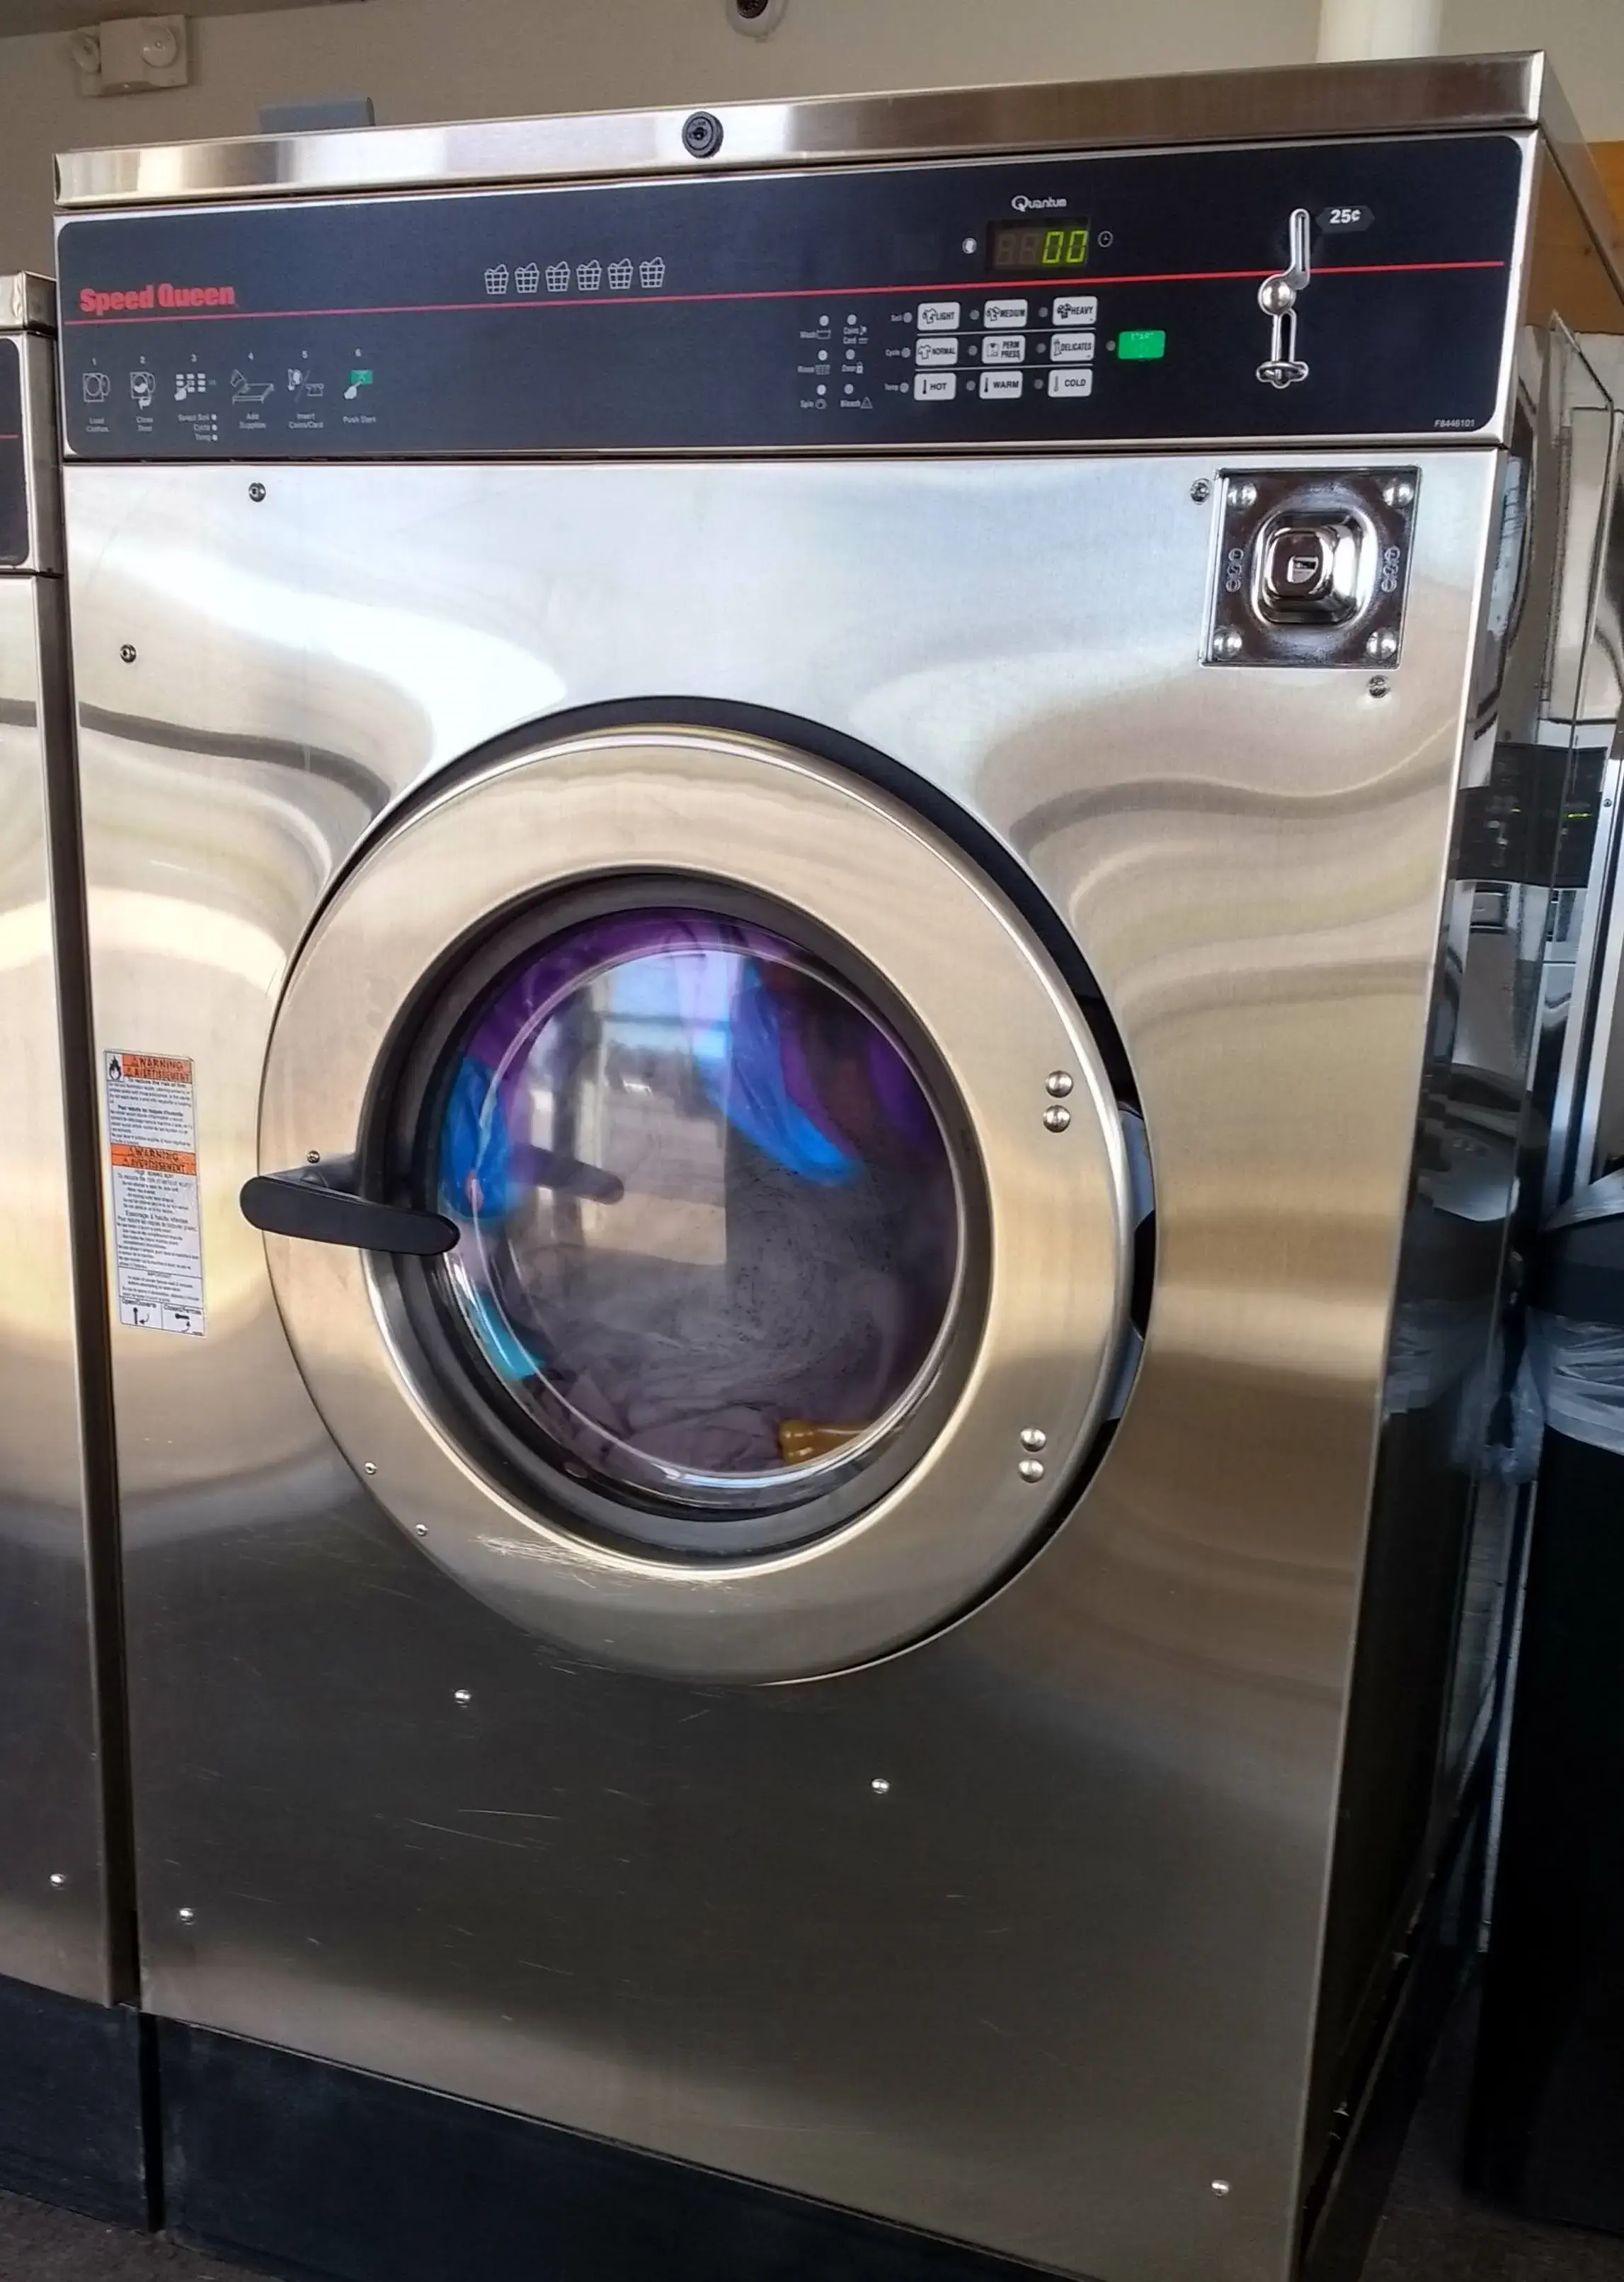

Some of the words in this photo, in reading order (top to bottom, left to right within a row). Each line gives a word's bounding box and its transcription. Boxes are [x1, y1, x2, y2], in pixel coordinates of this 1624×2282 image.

[1011, 195, 1067, 212] Quantum
[1329, 209, 1361, 224] 25¢
[80, 284, 154, 316] Speed
[157, 283, 235, 307] Queen
[1000, 309, 1025, 318] MEDIUM
[1071, 306, 1093, 315] HEAVY
[1060, 343, 1092, 351] DELICATES
[302, 350, 308, 359] 5
[355, 348, 361, 357] 6
[140, 355, 146, 364] 2
[191, 354, 197, 363] 3
[135, 1146, 178, 1161] WARNING
